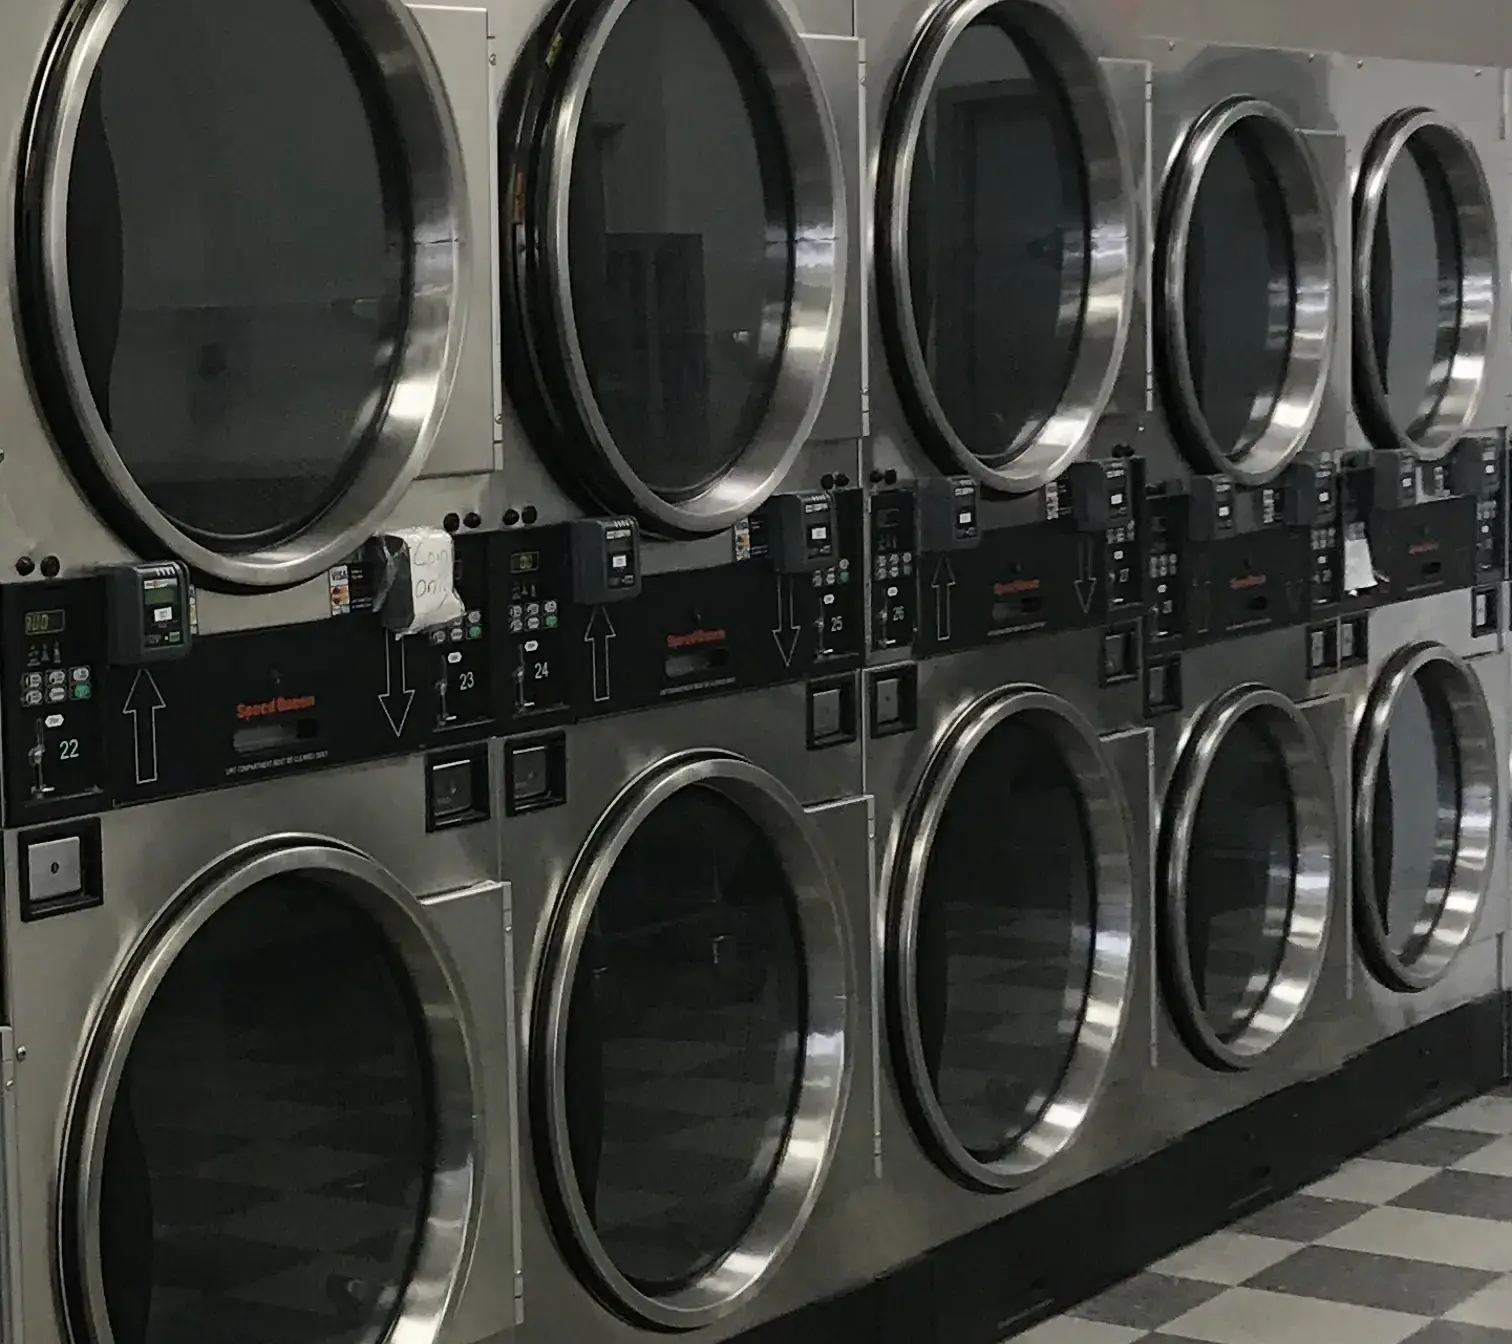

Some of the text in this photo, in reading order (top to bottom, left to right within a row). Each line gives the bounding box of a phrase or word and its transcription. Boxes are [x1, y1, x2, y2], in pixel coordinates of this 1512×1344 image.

[831, 615, 844, 632] 25
[534, 661, 550, 680] 24
[459, 671, 475, 691] 23
[59, 738, 80, 761] 22
